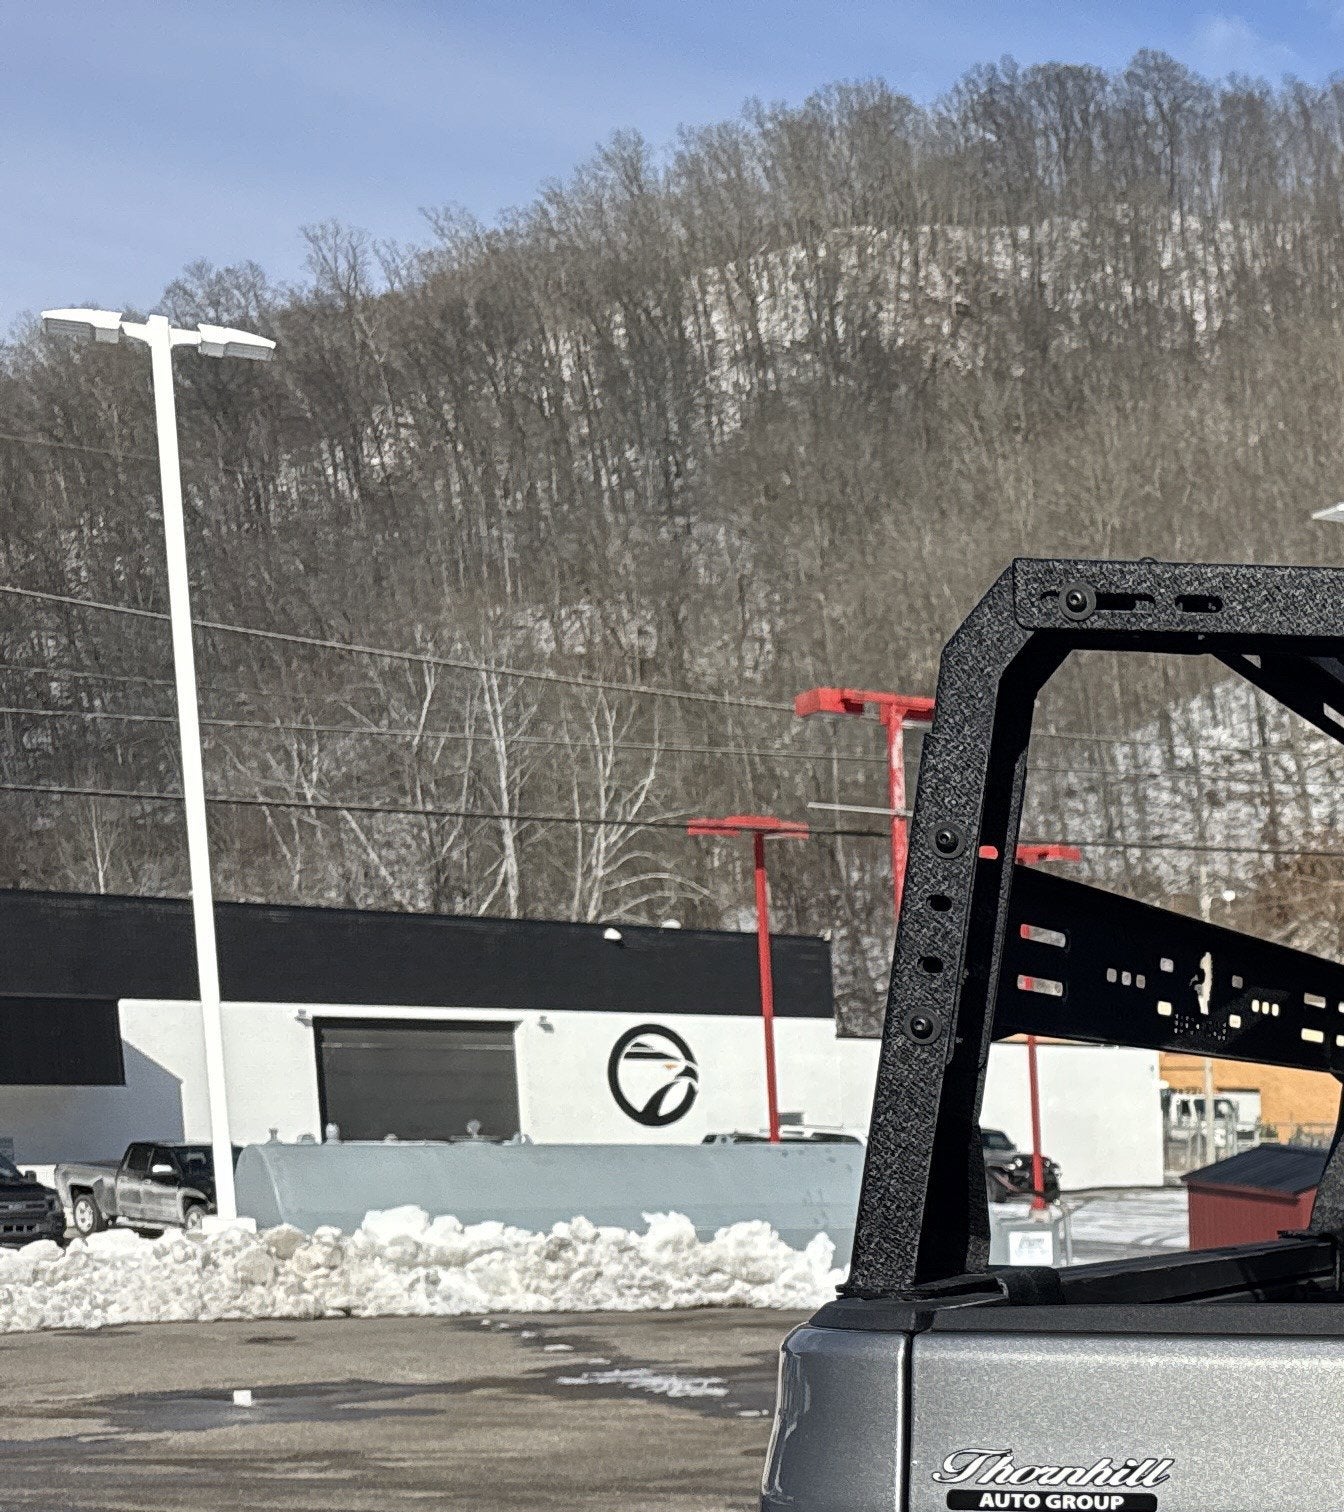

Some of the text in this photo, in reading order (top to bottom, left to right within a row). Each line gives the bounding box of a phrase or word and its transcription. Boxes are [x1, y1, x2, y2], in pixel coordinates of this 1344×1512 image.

[932, 1447, 1176, 1488] Thornhill
[978, 1492, 1125, 1511] AUTO GROUP
